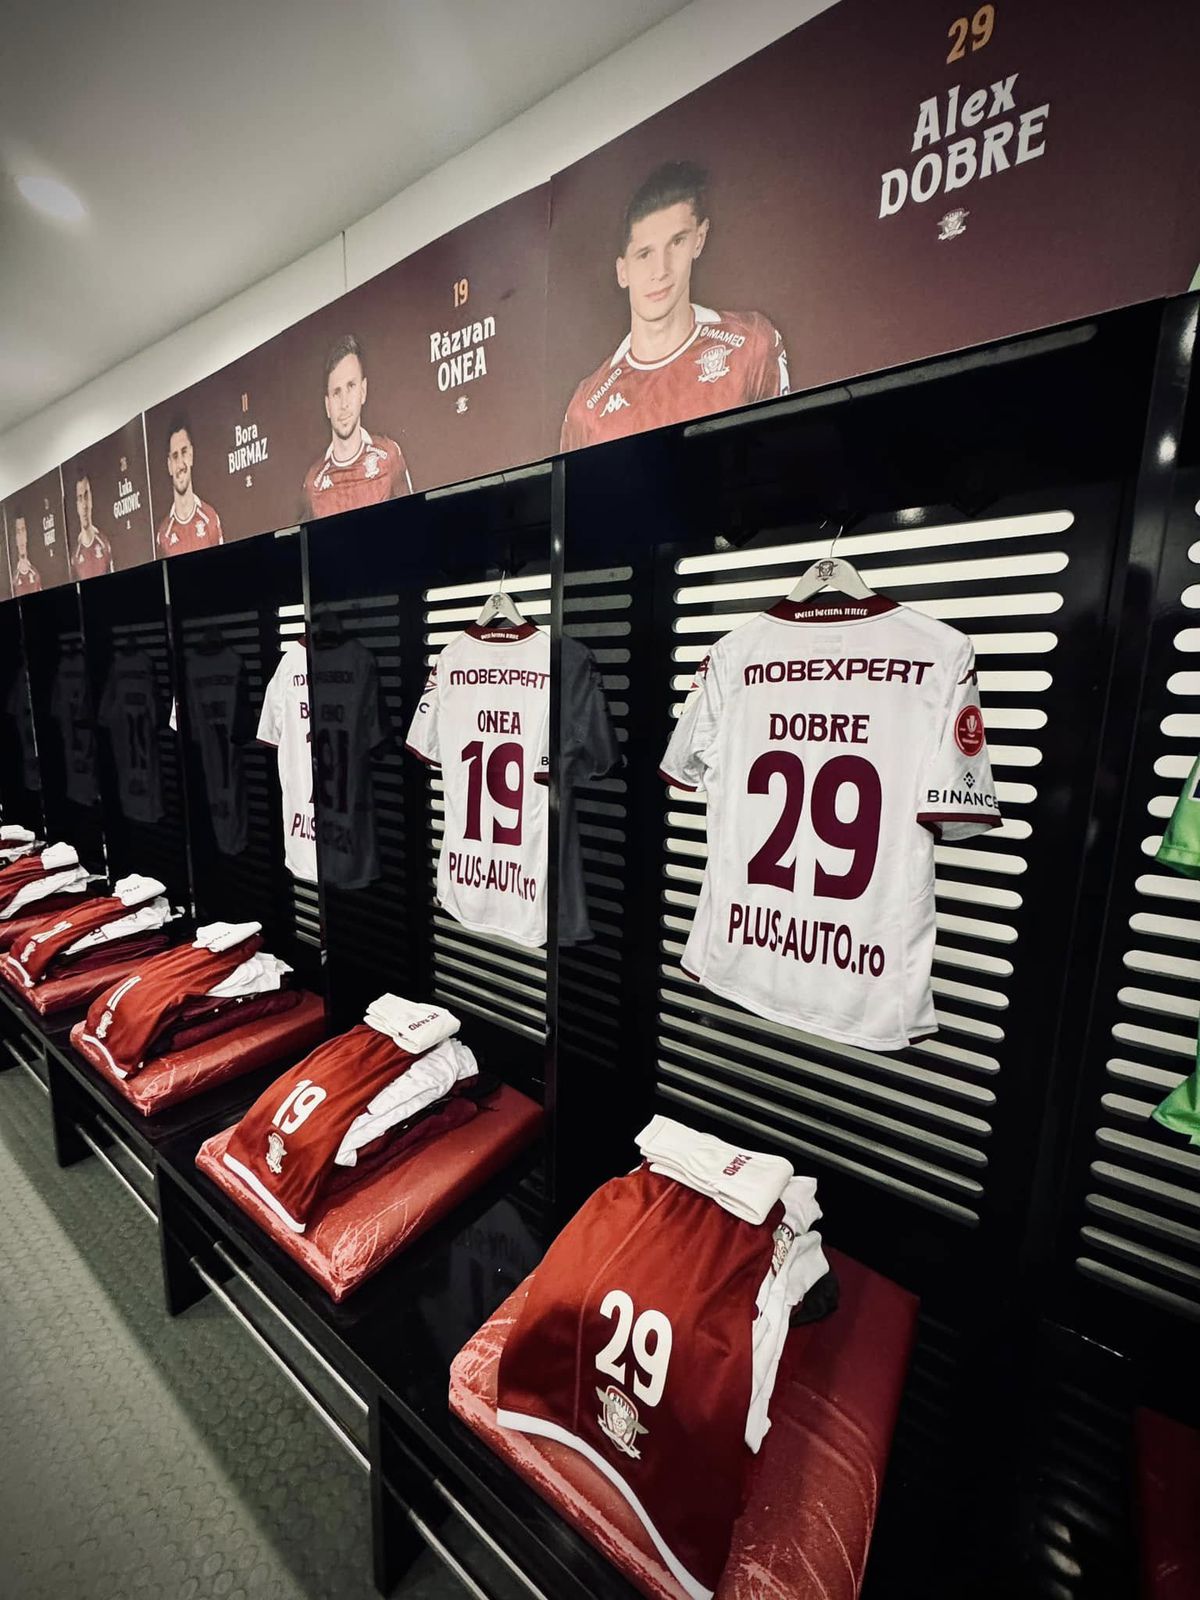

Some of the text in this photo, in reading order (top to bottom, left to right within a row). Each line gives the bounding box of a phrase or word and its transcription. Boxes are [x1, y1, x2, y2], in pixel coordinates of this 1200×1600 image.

[946, 3, 996, 64] 29
[911, 73, 1019, 152] Alex
[878, 103, 1050, 219] DOBRE
[453, 278, 469, 308] 19
[437, 346, 487, 391] ONEA
[228, 437, 268, 474] BURMAZ
[235, 424, 258, 446] Bora
[450, 668, 550, 690] MOBEXPERT
[744, 657, 935, 686] MOBEXPERT
[477, 710, 521, 735] ONEA
[769, 713, 870, 744] DOBRE
[461, 740, 525, 847] 19
[747, 749, 883, 901] 29
[728, 903, 885, 979] PLUS-AUTO.ro
[271, 1078, 328, 1136] 19
[595, 1289, 673, 1408] 29
